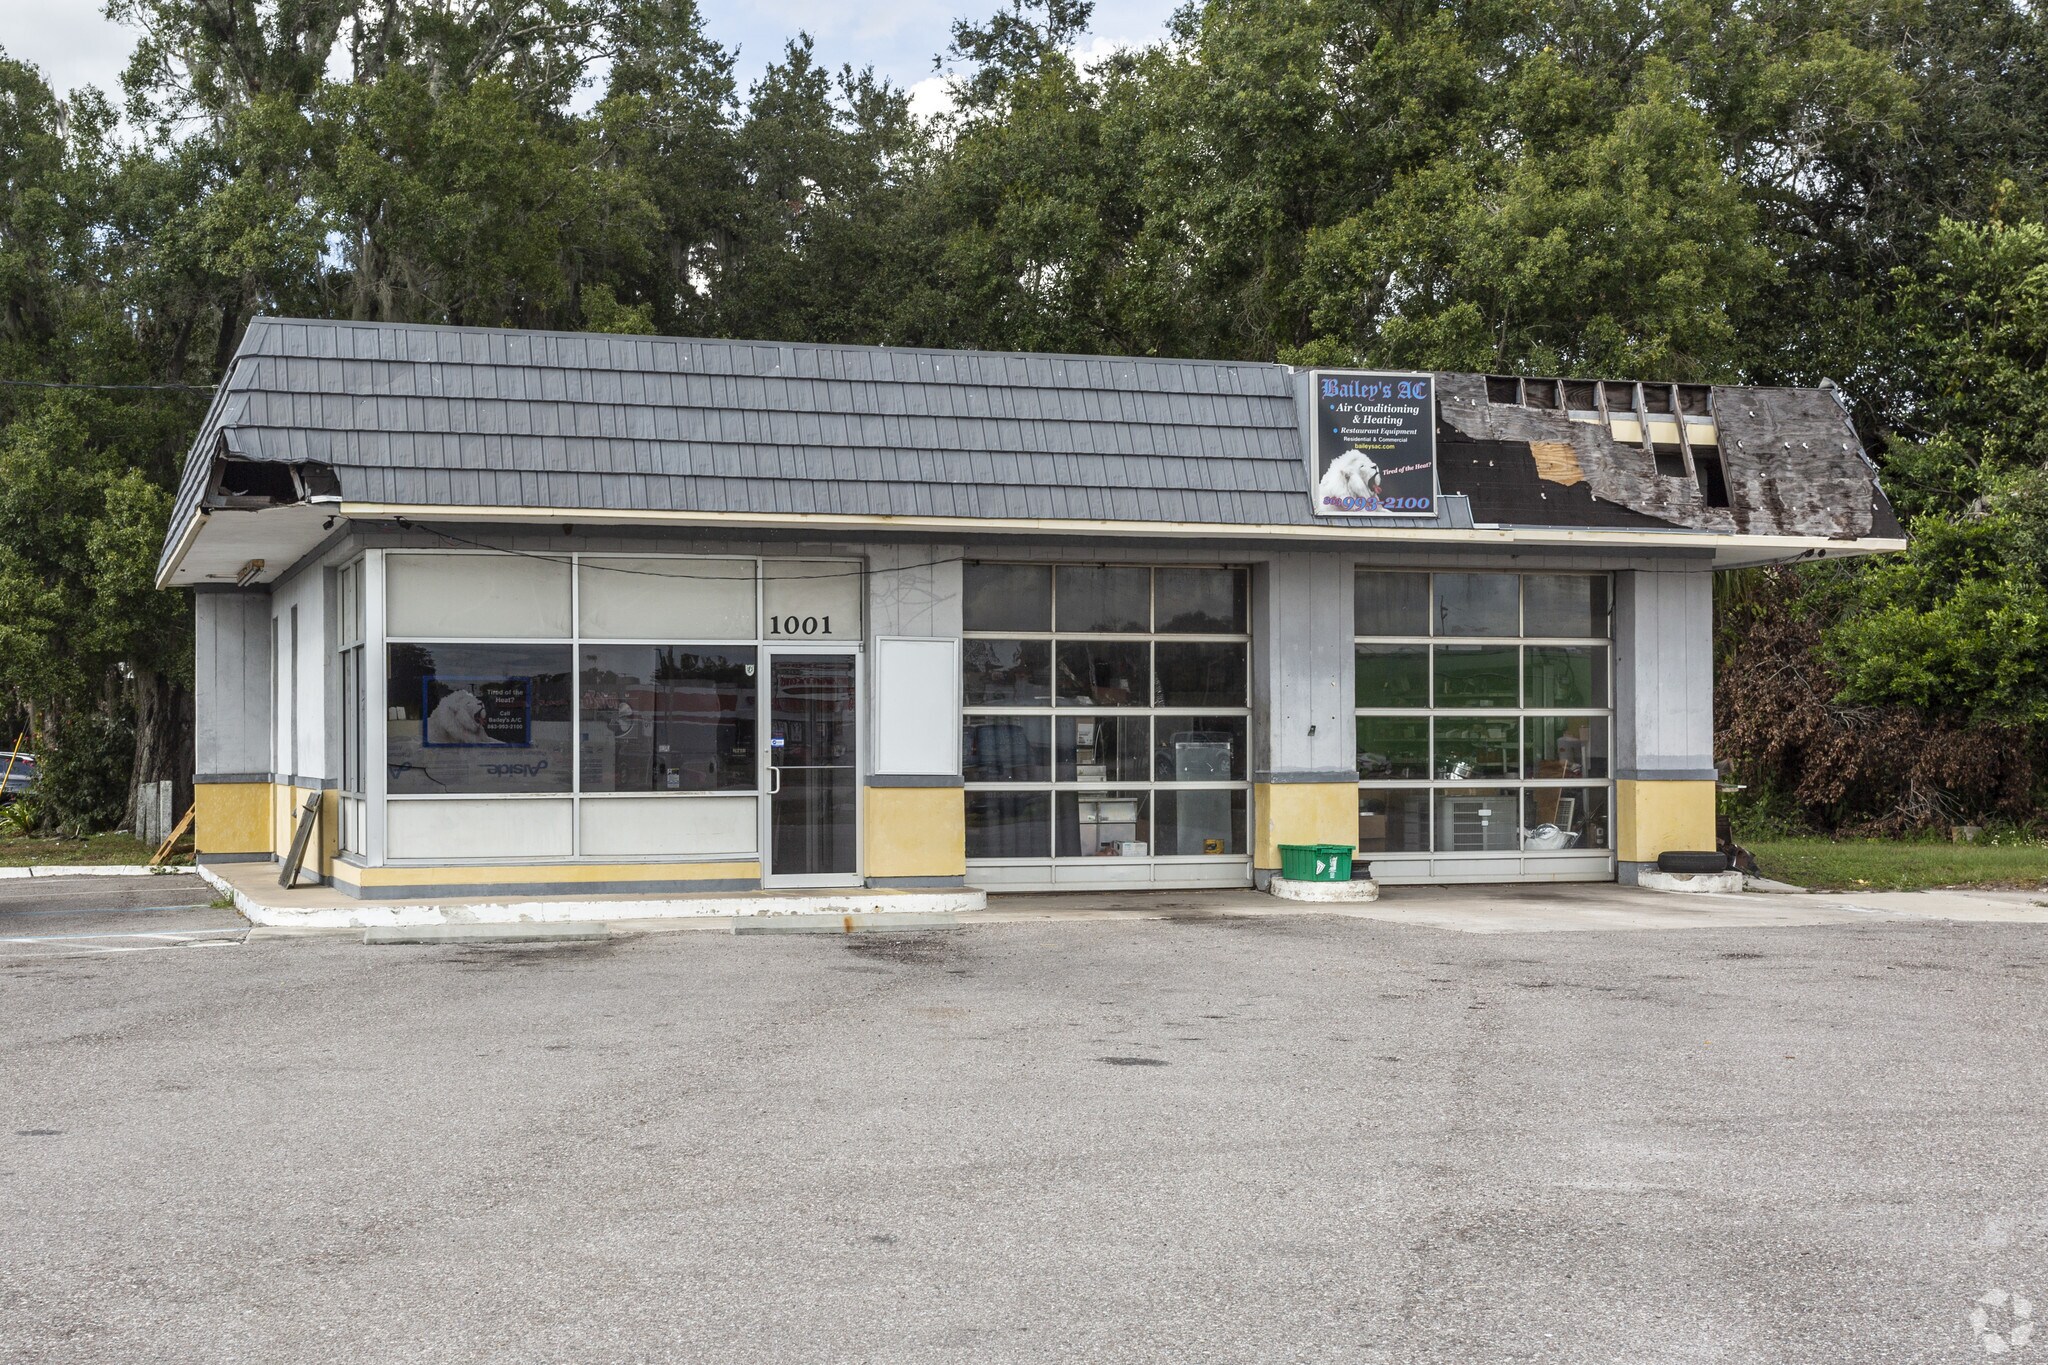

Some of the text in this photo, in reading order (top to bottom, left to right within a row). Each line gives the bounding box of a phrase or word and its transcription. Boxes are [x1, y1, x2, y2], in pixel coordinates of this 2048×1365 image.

[1321, 378, 1427, 401] Bailey's AC
[1336, 403, 1420, 415] Air Conditioning
[1352, 415, 1403, 427] & Heating
[1340, 427, 1417, 436] Restaurant Equipment
[1382, 467, 1398, 476] Tired
[1415, 462, 1431, 470] Heat?
[1342, 496, 1430, 512] 993-2100
[770, 615, 832, 635] 1001
[479, 760, 548, 778] Alside
